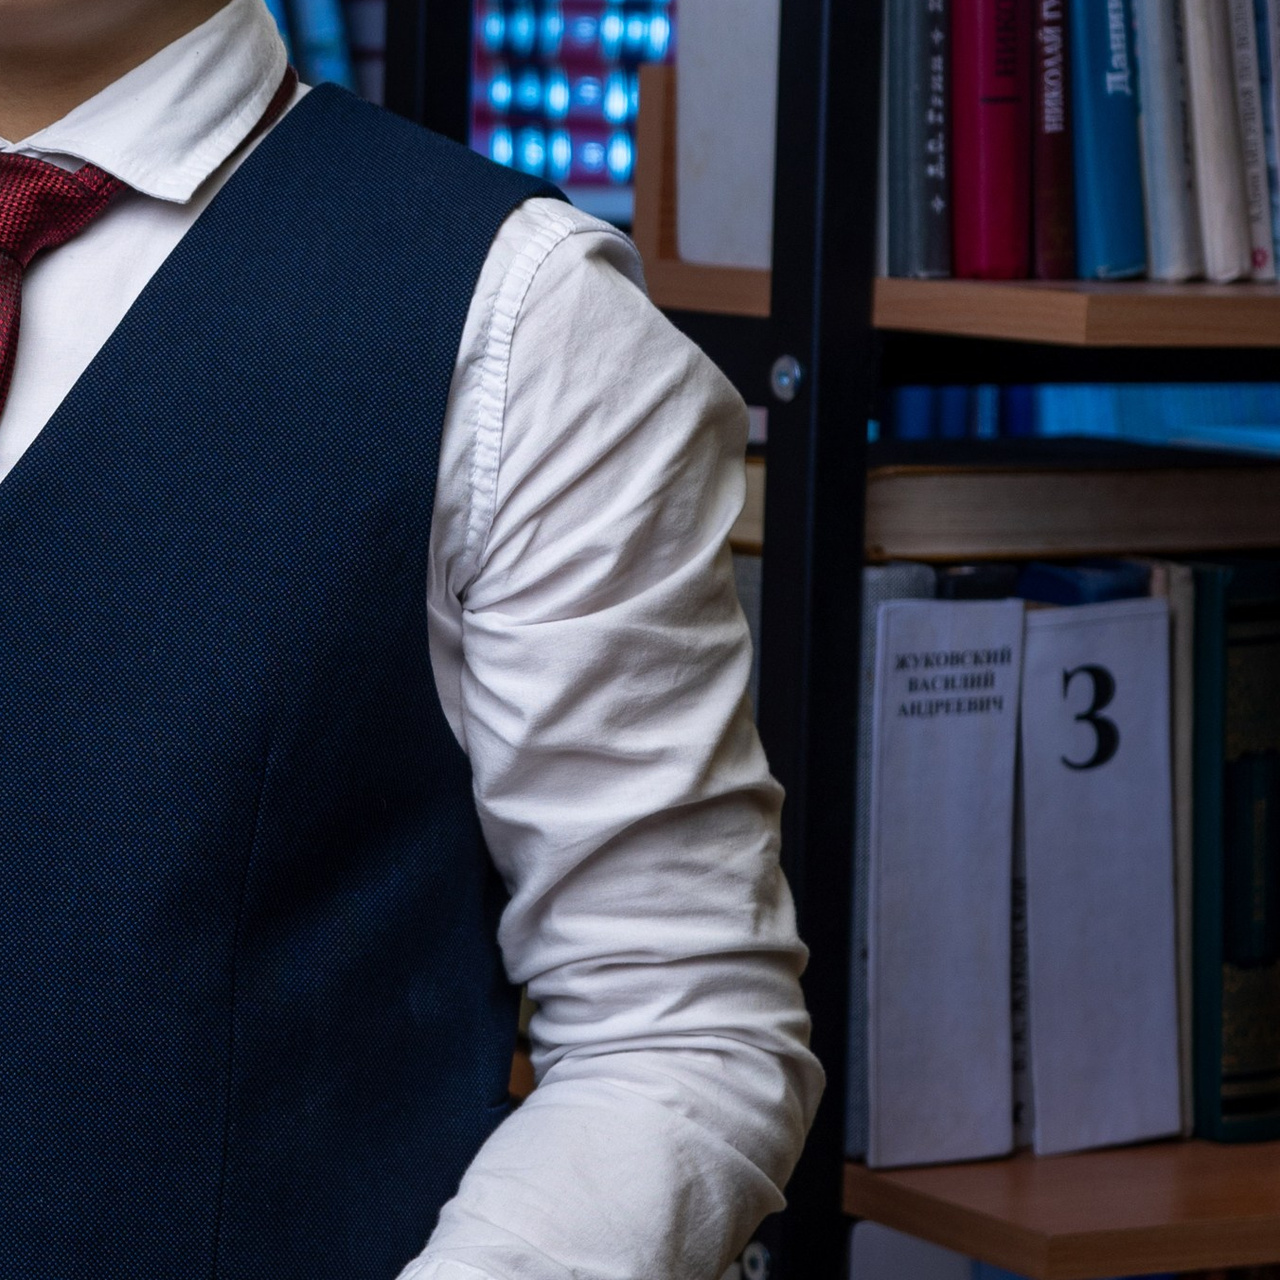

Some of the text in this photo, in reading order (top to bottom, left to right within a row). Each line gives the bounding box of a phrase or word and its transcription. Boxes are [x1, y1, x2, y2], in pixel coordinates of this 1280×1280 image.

[1038, 28, 1065, 133] НИКОЛАЙ
[895, 644, 1012, 670] ЖУКОВСКИЙ
[908, 671, 995, 693] ВАСИЛИЙ
[898, 695, 1004, 718] АНДРЕЕВИЧ
